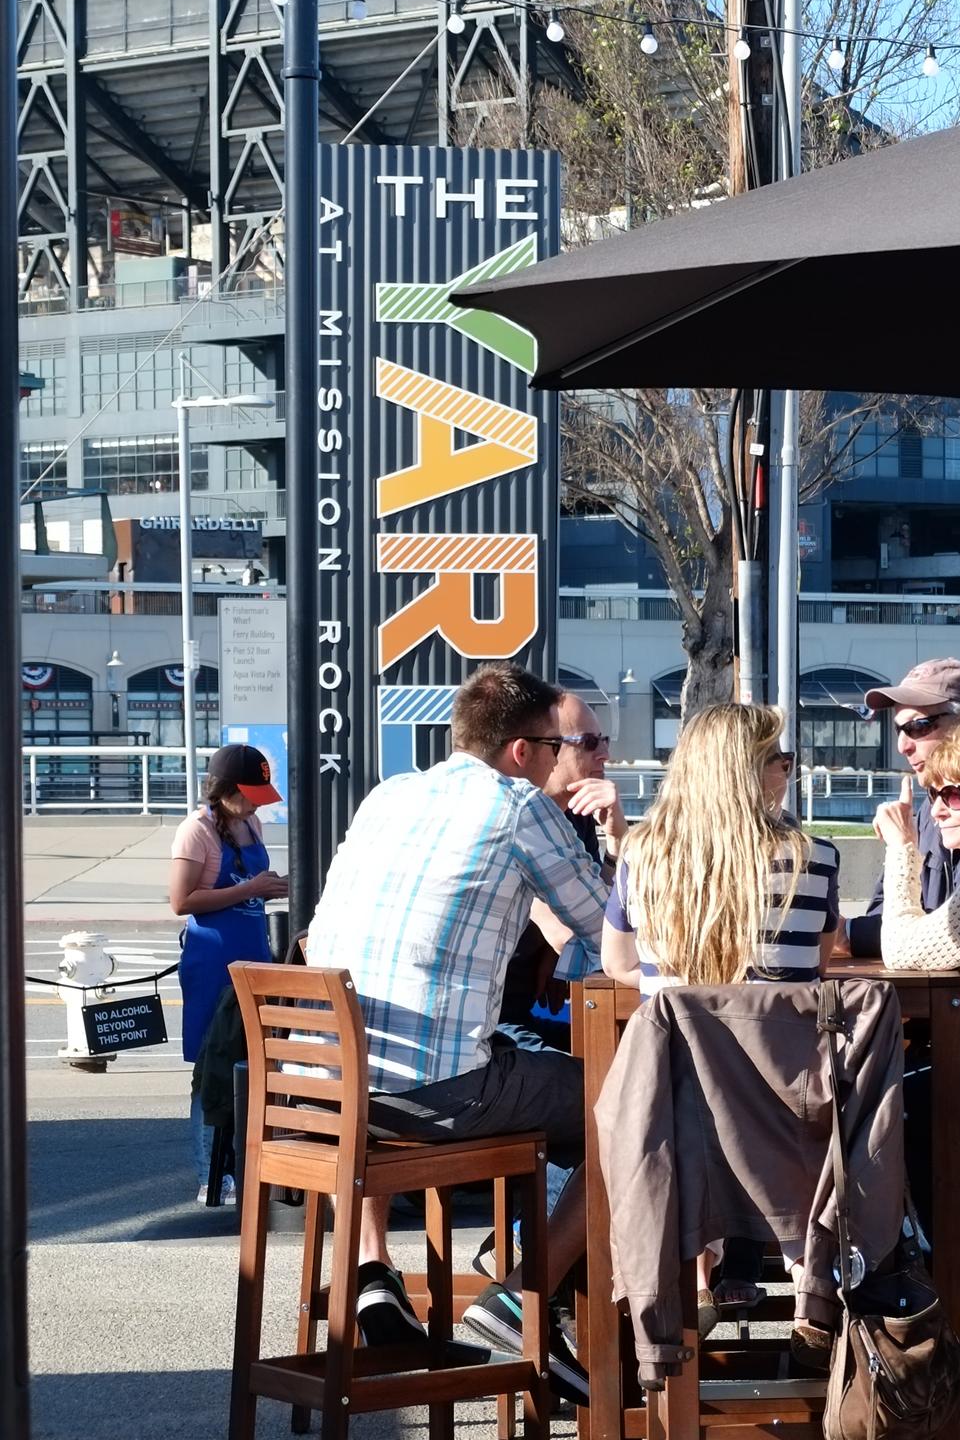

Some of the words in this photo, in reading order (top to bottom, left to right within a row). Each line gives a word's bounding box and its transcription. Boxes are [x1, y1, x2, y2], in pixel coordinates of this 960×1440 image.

[376, 176, 538, 220] THE
[319, 196, 343, 262] AT
[318, 310, 343, 571] MISSION
[232, 616, 251, 625] Wharf
[232, 630, 249, 640] Ferry
[250, 630, 275, 640] Building
[233, 646, 246, 655] Pier
[233, 656, 256, 665] Launch
[266, 670, 281, 679] Park
[257, 683, 273, 692] Head
[233, 694, 248, 703] Park
[319, 621, 342, 775] ROCK
[94, 1011, 109, 1022] NO
[110, 1004, 152, 1019] ALCOHOL
[96, 1019, 136, 1034] BEYOND
[98, 1034, 120, 1045] THIS
[121, 1029, 148, 1042] POINT
